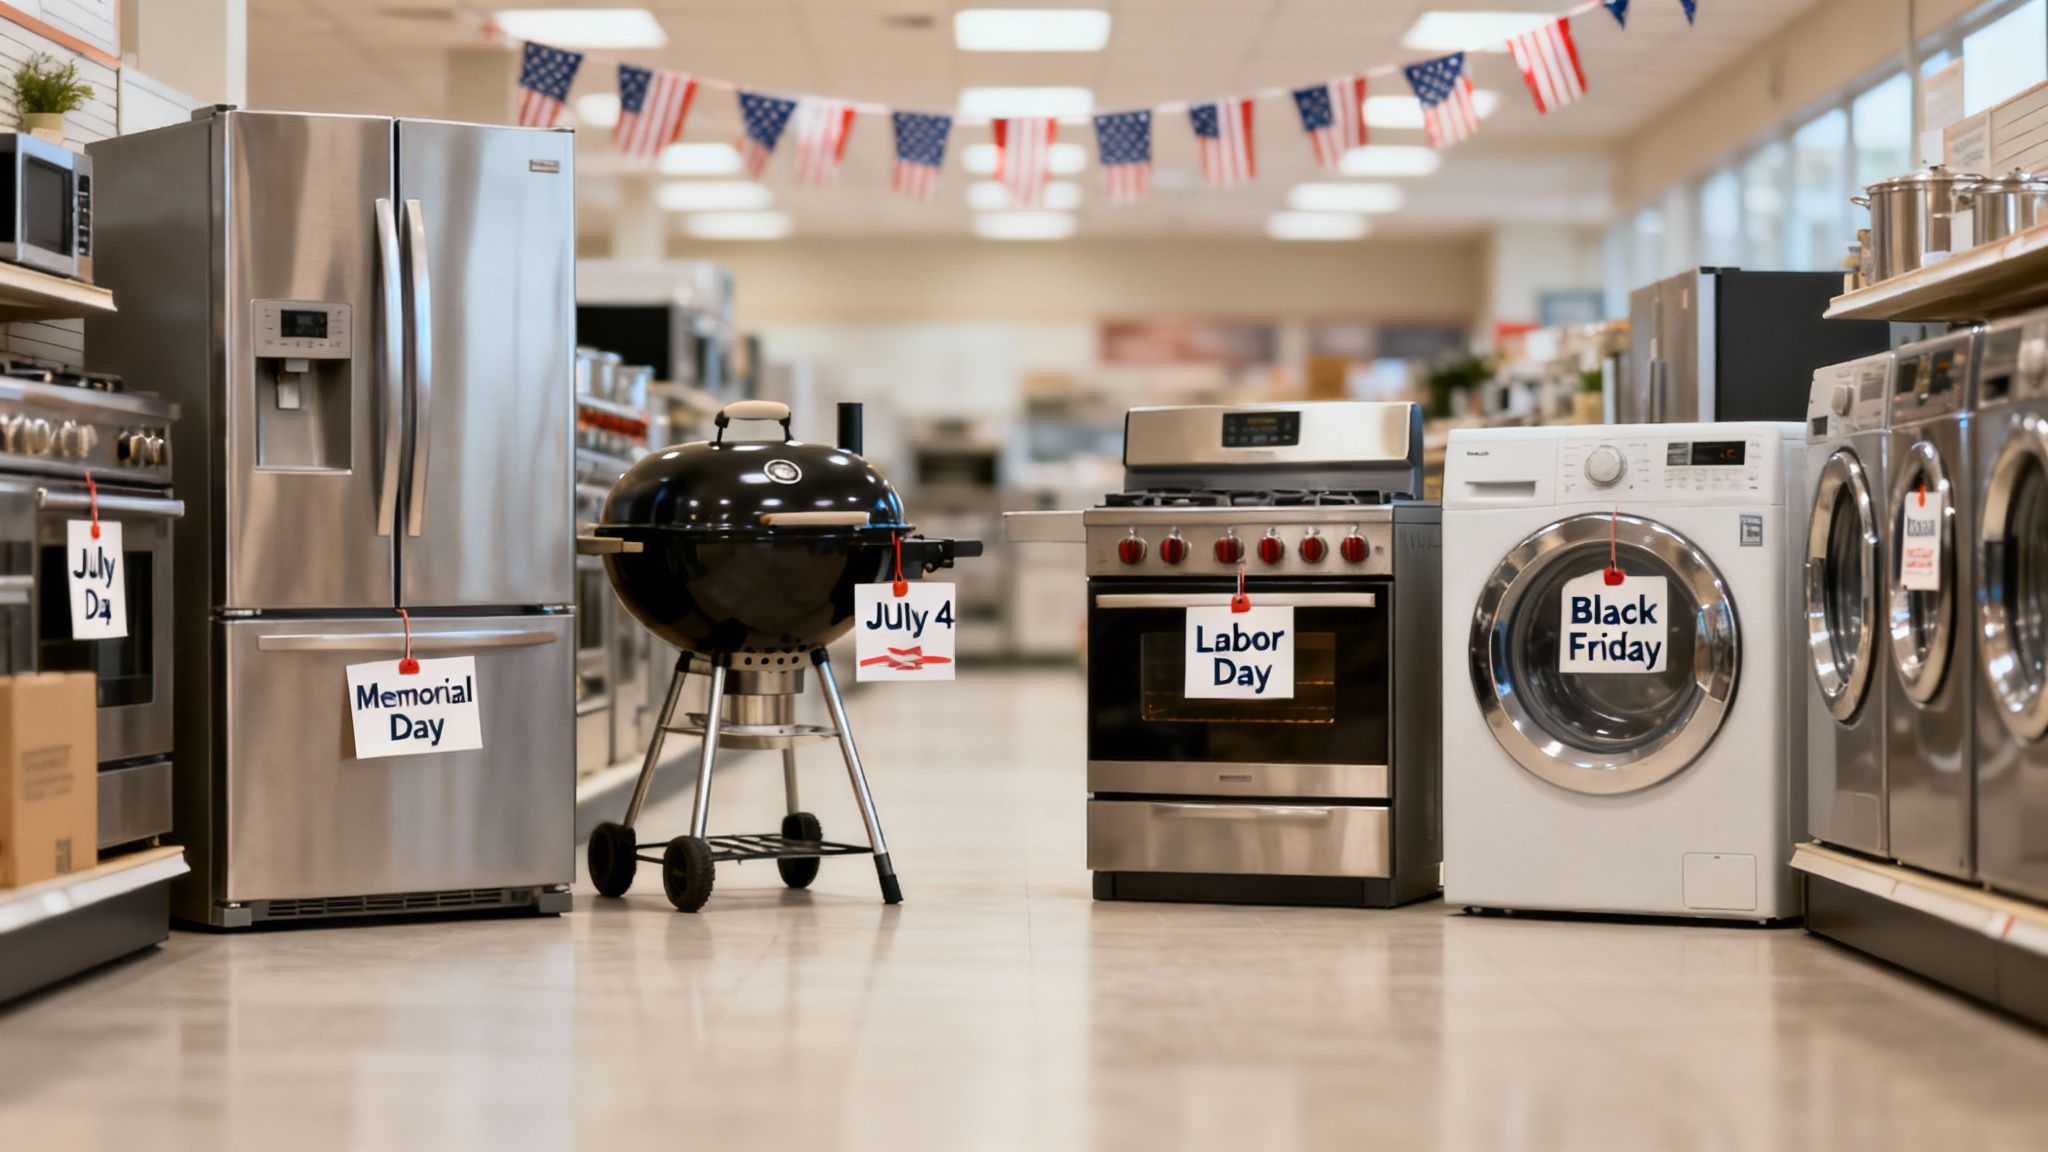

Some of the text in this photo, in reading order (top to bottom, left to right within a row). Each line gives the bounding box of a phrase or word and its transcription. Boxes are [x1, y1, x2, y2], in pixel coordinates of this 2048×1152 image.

[866, 600, 955, 638] July 4
[1571, 594, 1658, 626] Black
[1197, 622, 1285, 653] Labor
[1569, 631, 1662, 670] Friday
[356, 675, 473, 710] Memorial
[1214, 657, 1273, 694] Day
[390, 713, 445, 746] Day
